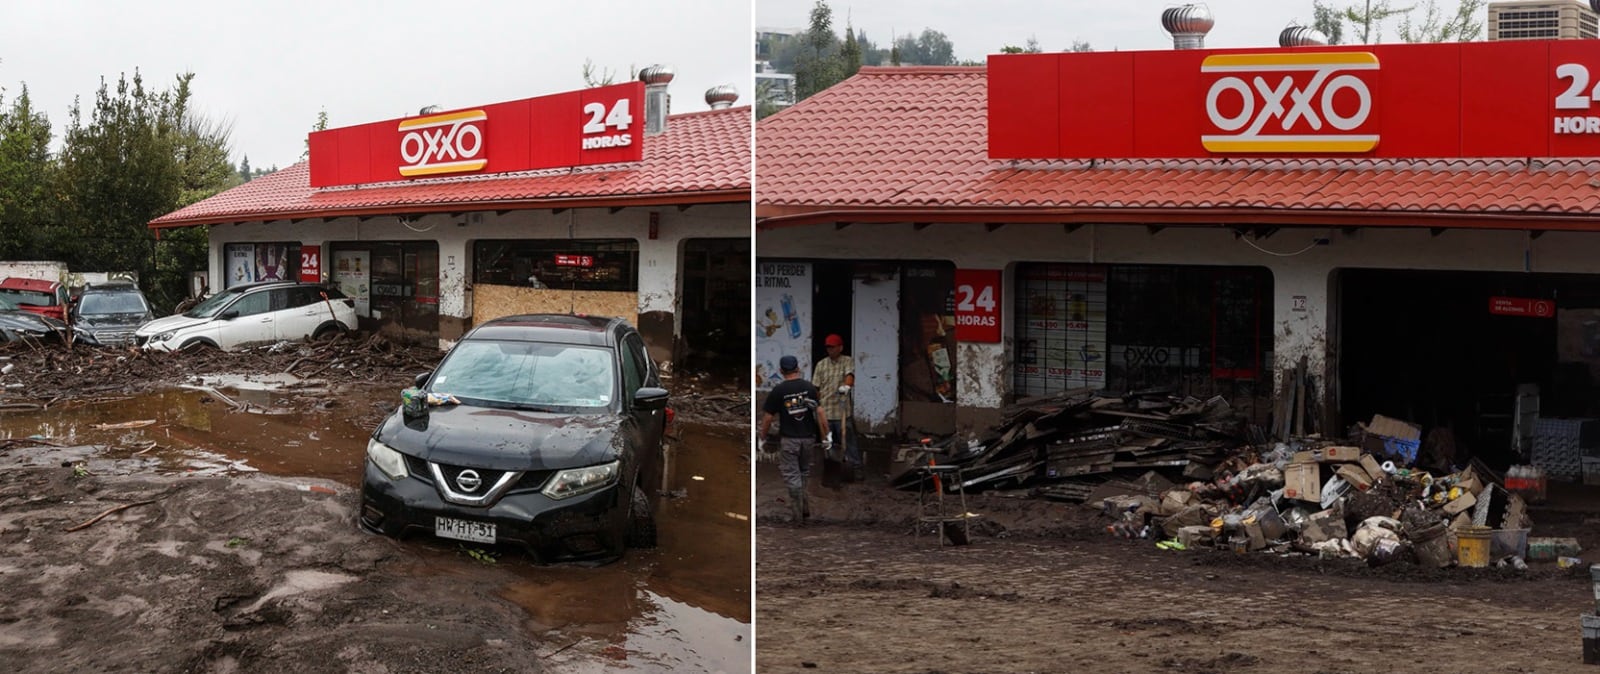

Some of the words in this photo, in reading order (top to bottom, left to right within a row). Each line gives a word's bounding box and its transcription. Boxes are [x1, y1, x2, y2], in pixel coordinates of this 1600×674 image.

[1206, 70, 1371, 135] OXXO
[583, 98, 632, 133] 24
[400, 121, 482, 166] OXXO
[582, 134, 632, 149] HORAS
[302, 253, 318, 267] 24
[763, 262, 775, 275] NO
[777, 262, 805, 276] PERDER
[958, 285, 996, 312] 24
[957, 315, 996, 326] HORAS
[1124, 346, 1168, 367] OXXO
